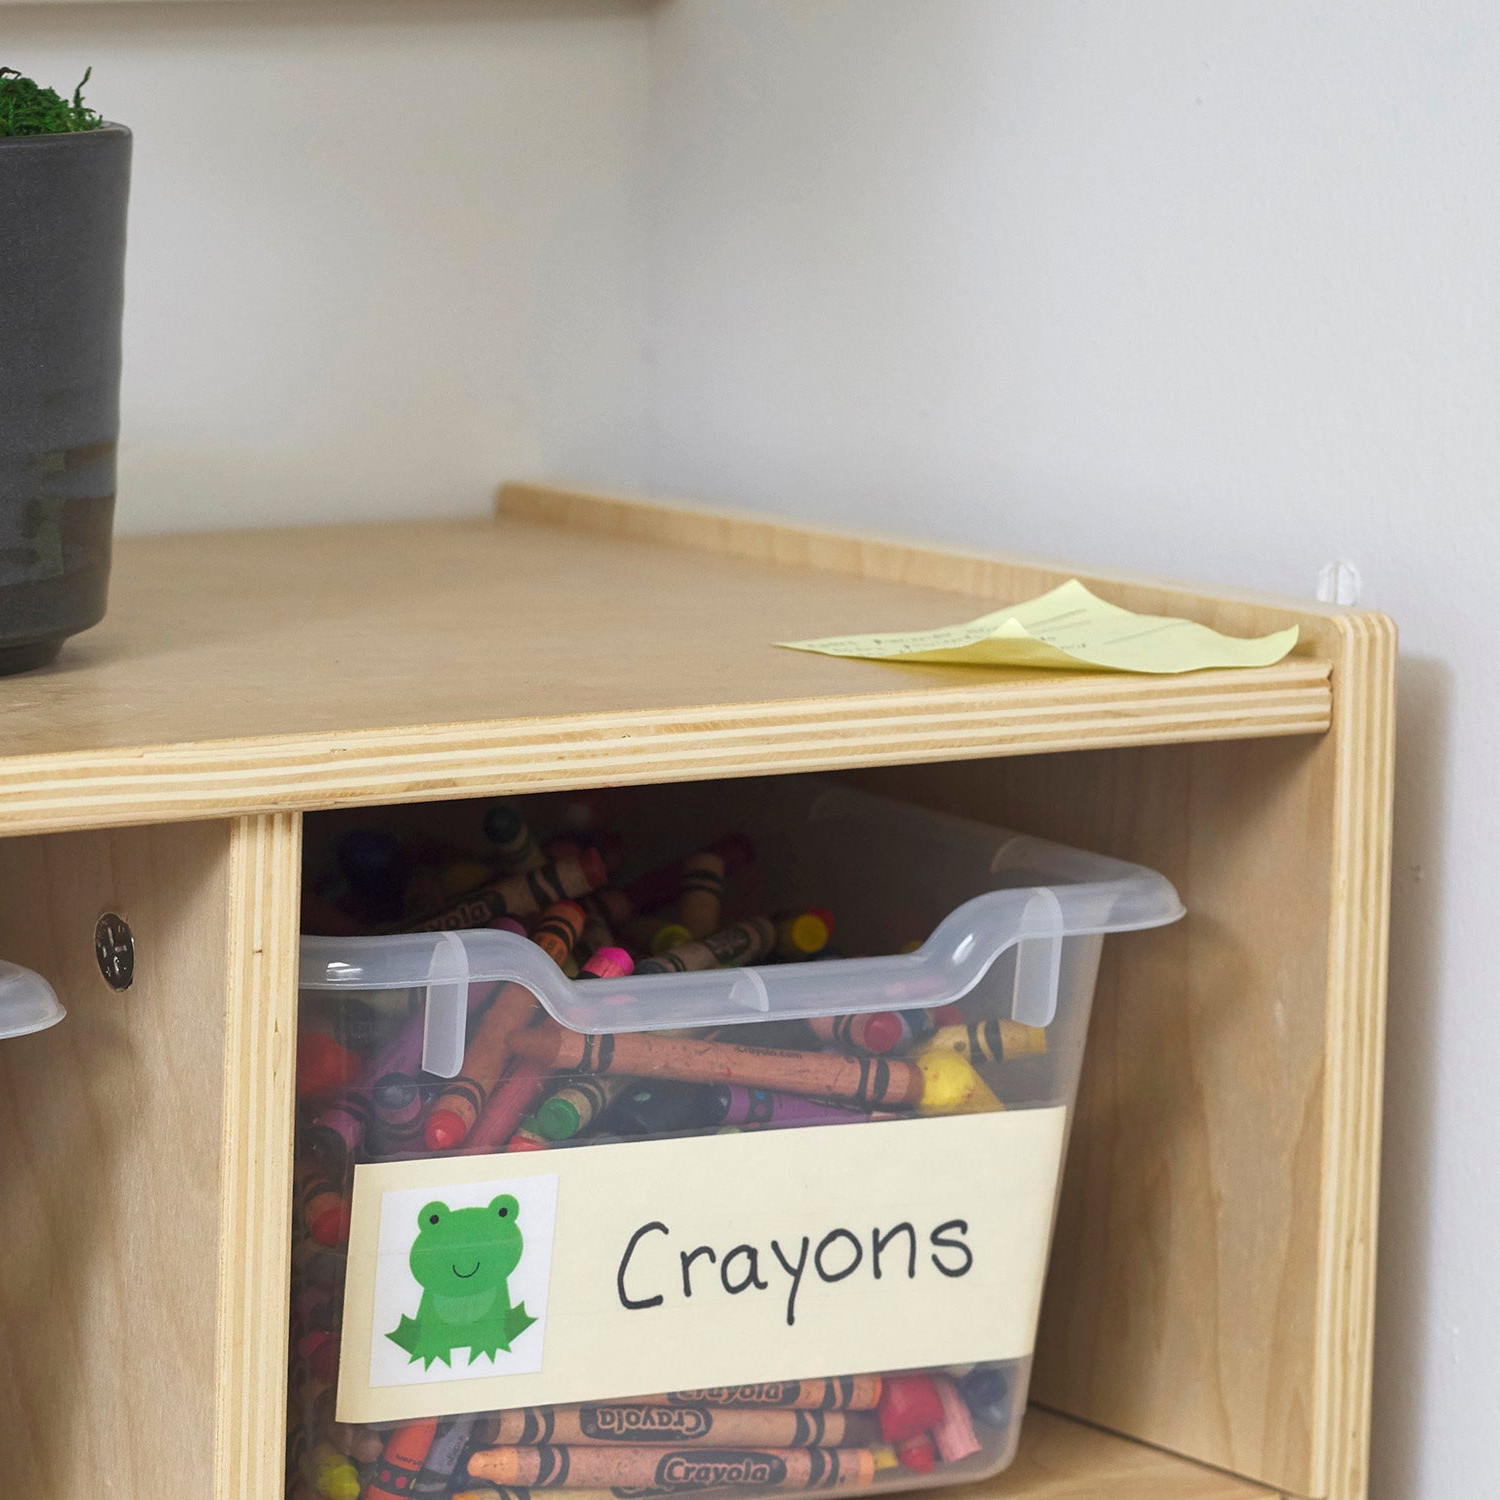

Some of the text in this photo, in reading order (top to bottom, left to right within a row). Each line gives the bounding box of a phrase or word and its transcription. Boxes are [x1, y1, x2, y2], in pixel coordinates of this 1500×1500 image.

[616, 1218, 974, 1328] Crayons
[596, 1405, 703, 1434] Crayola
[664, 1457, 770, 1484] Crayola
